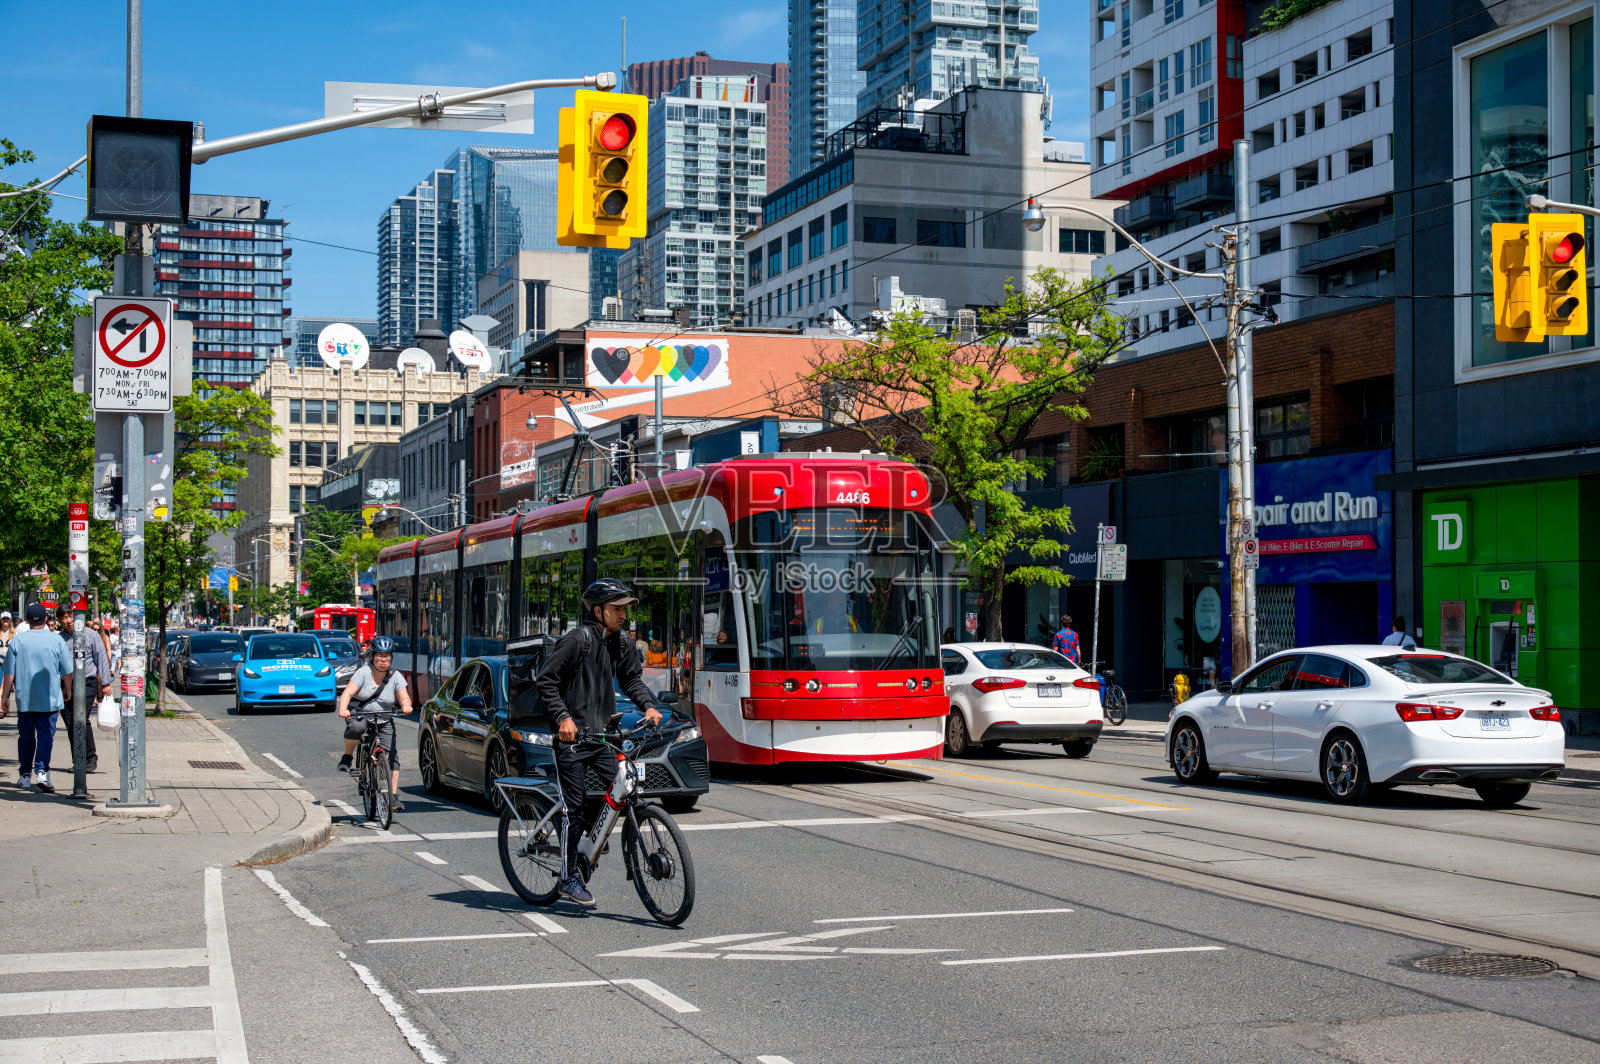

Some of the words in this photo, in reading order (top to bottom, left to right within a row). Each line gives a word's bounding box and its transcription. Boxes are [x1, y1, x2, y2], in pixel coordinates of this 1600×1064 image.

[116, 380, 131, 388] MON
[836, 491, 871, 505] 4486
[1290, 492, 1333, 525] and
[1334, 491, 1378, 522] Run
[1431, 513, 1463, 551] TD
[1304, 542, 1309, 550] &
[1310, 540, 1341, 550] E-Scooter
[1342, 538, 1364, 550] Repair
[1500, 579, 1510, 591] TD
